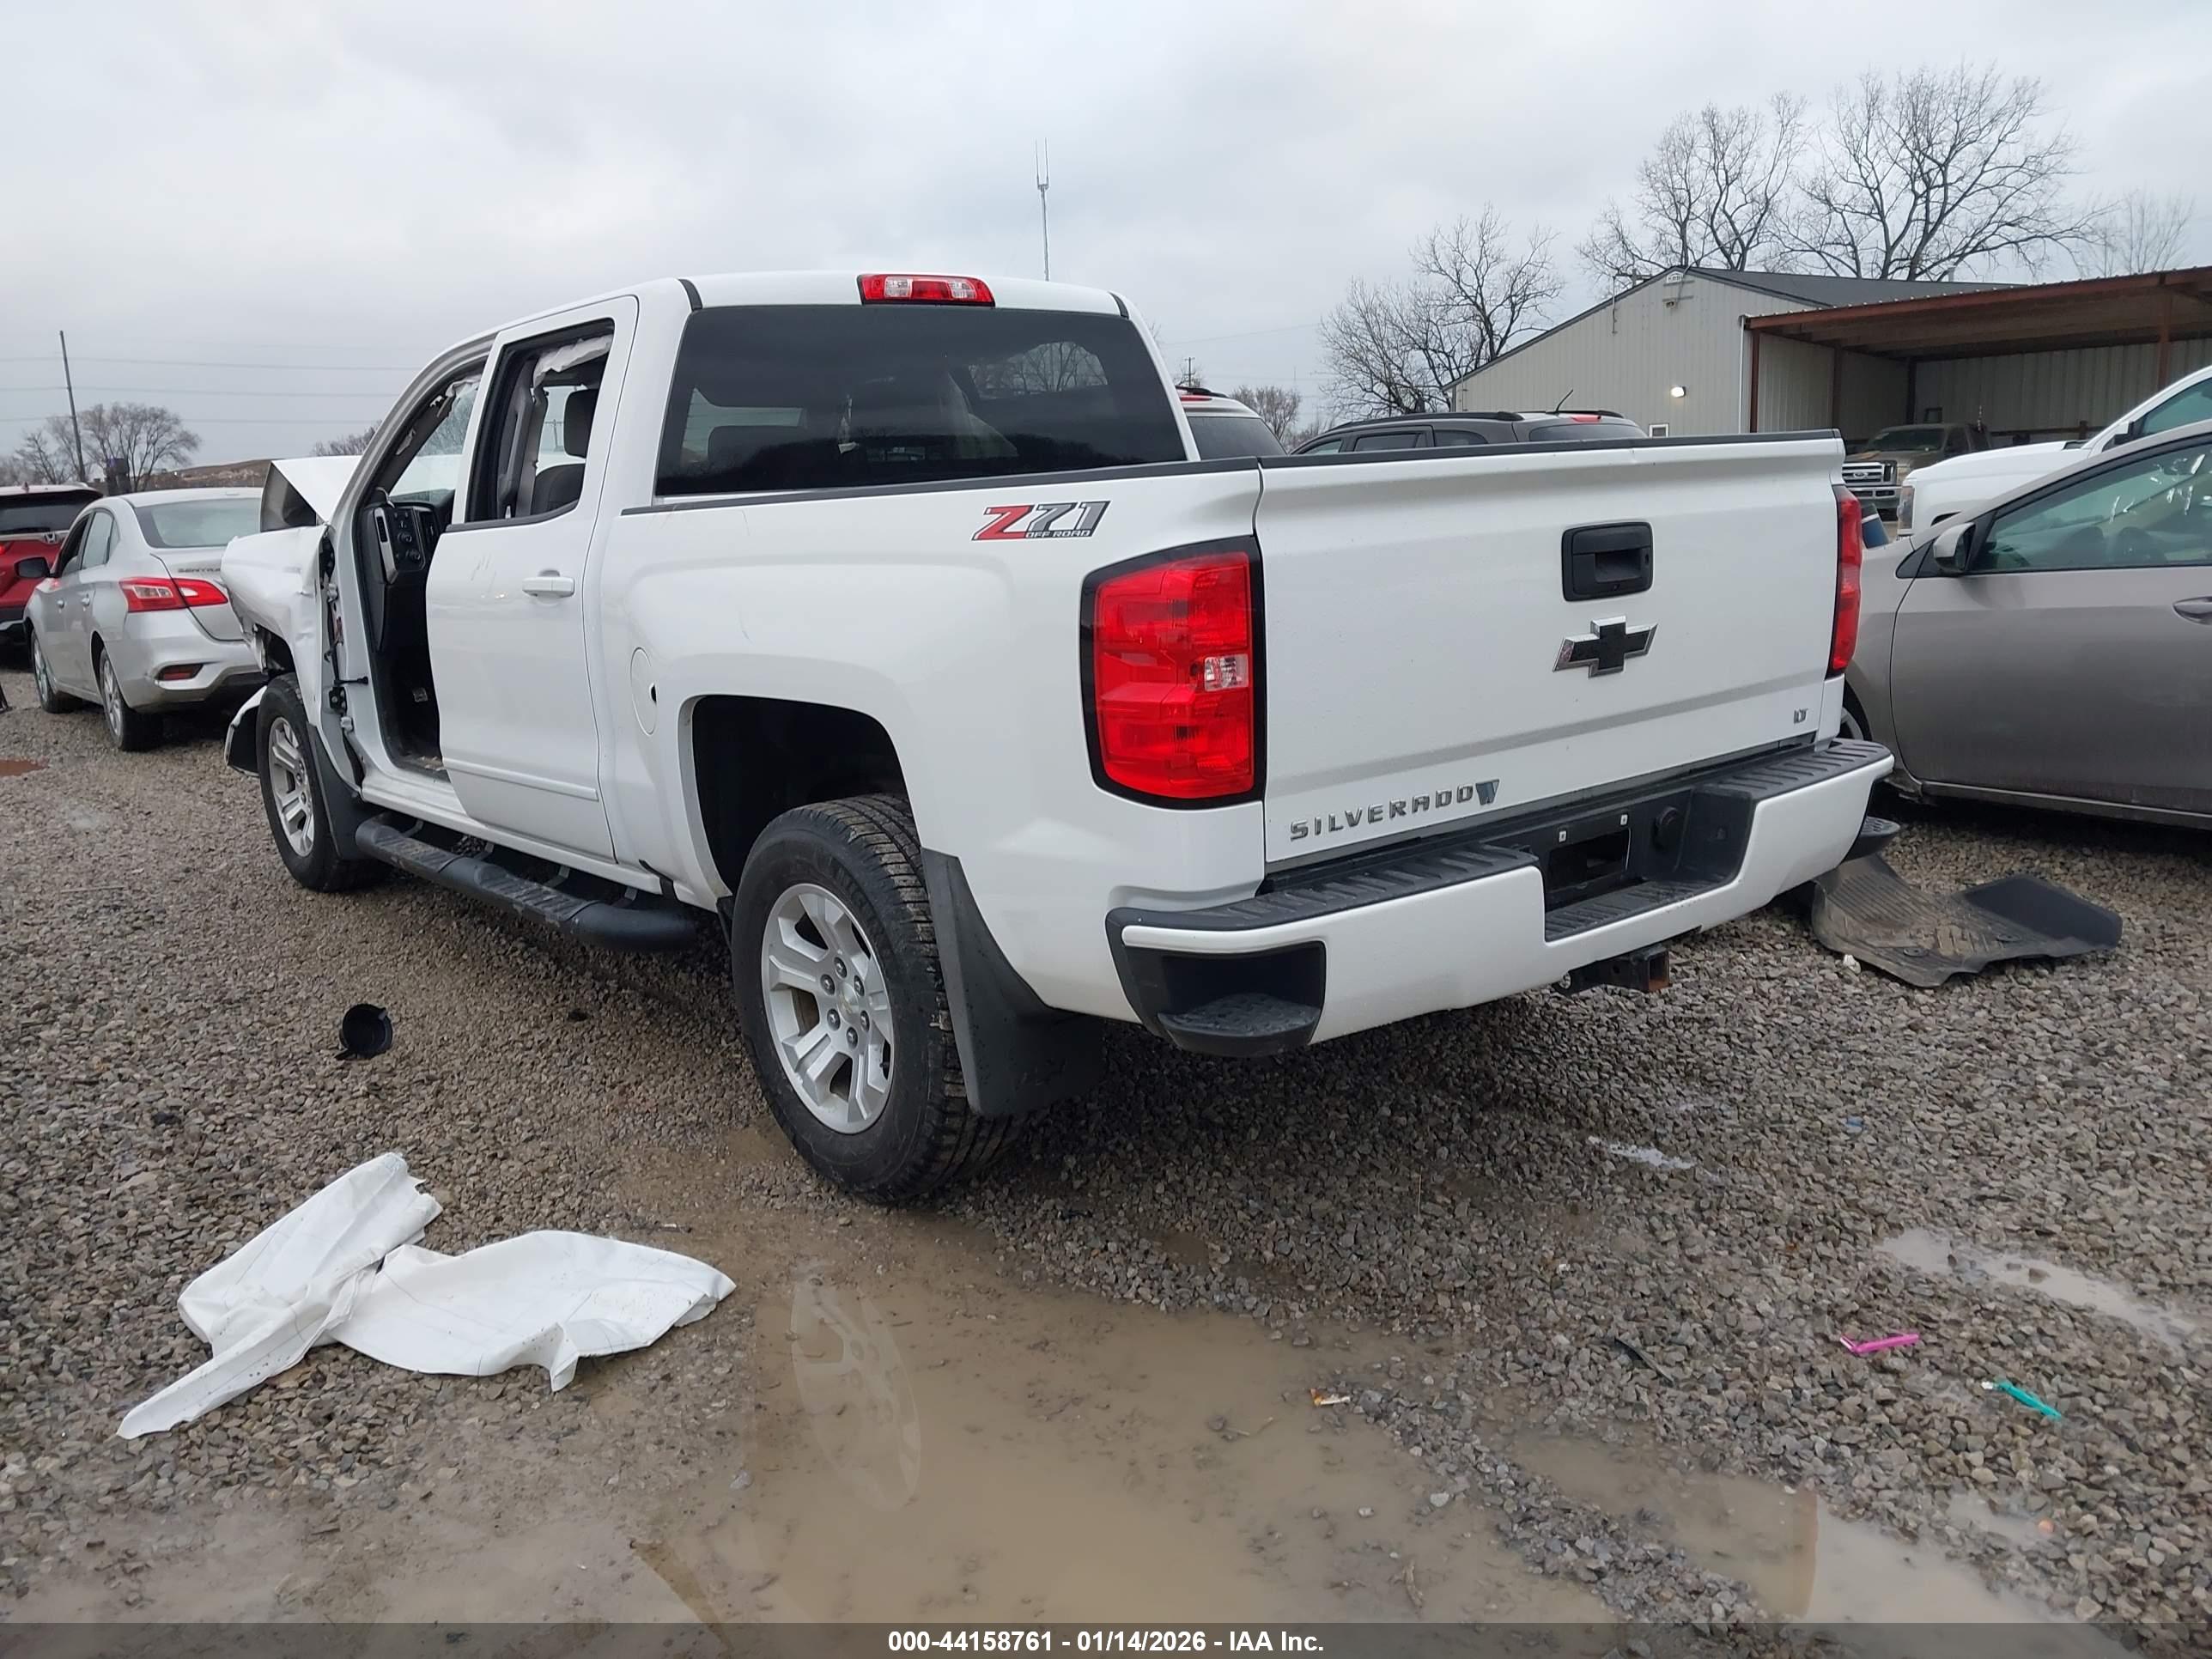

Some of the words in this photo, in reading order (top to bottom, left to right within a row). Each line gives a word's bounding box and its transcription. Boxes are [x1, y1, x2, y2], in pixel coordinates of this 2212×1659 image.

[971, 500, 1111, 541] Z71
[1024, 530, 1052, 539] OFF
[1052, 529, 1091, 538] ROAD
[1290, 782, 1474, 842] SILVERADO
